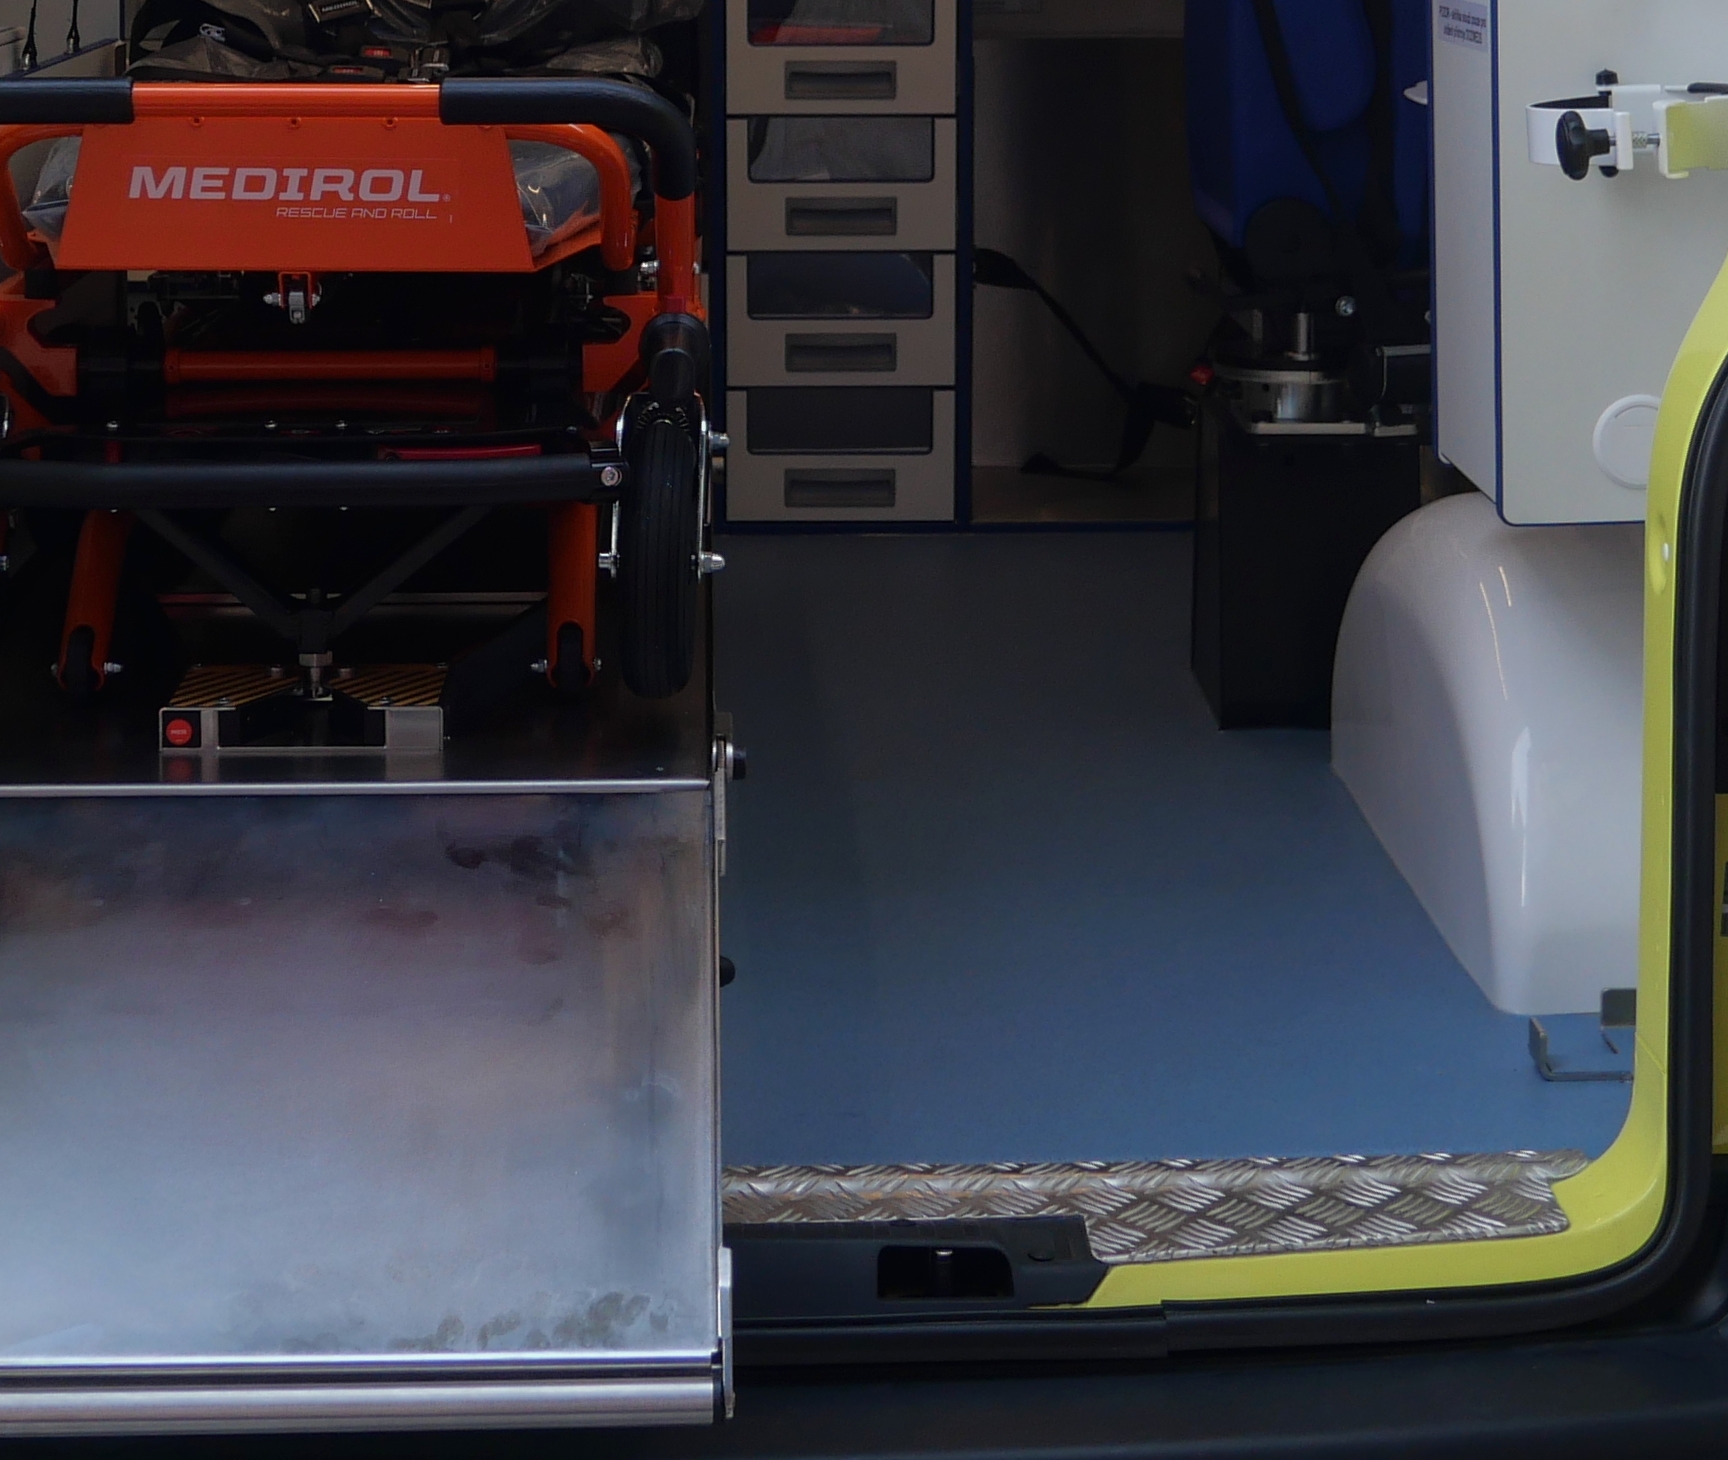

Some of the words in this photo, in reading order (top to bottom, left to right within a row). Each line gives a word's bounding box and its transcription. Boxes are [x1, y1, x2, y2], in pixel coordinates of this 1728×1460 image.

[128, 165, 441, 203] MEDIROL
[276, 206, 346, 219] RESCUE
[351, 207, 386, 219] AND
[390, 208, 438, 220] ROLL
